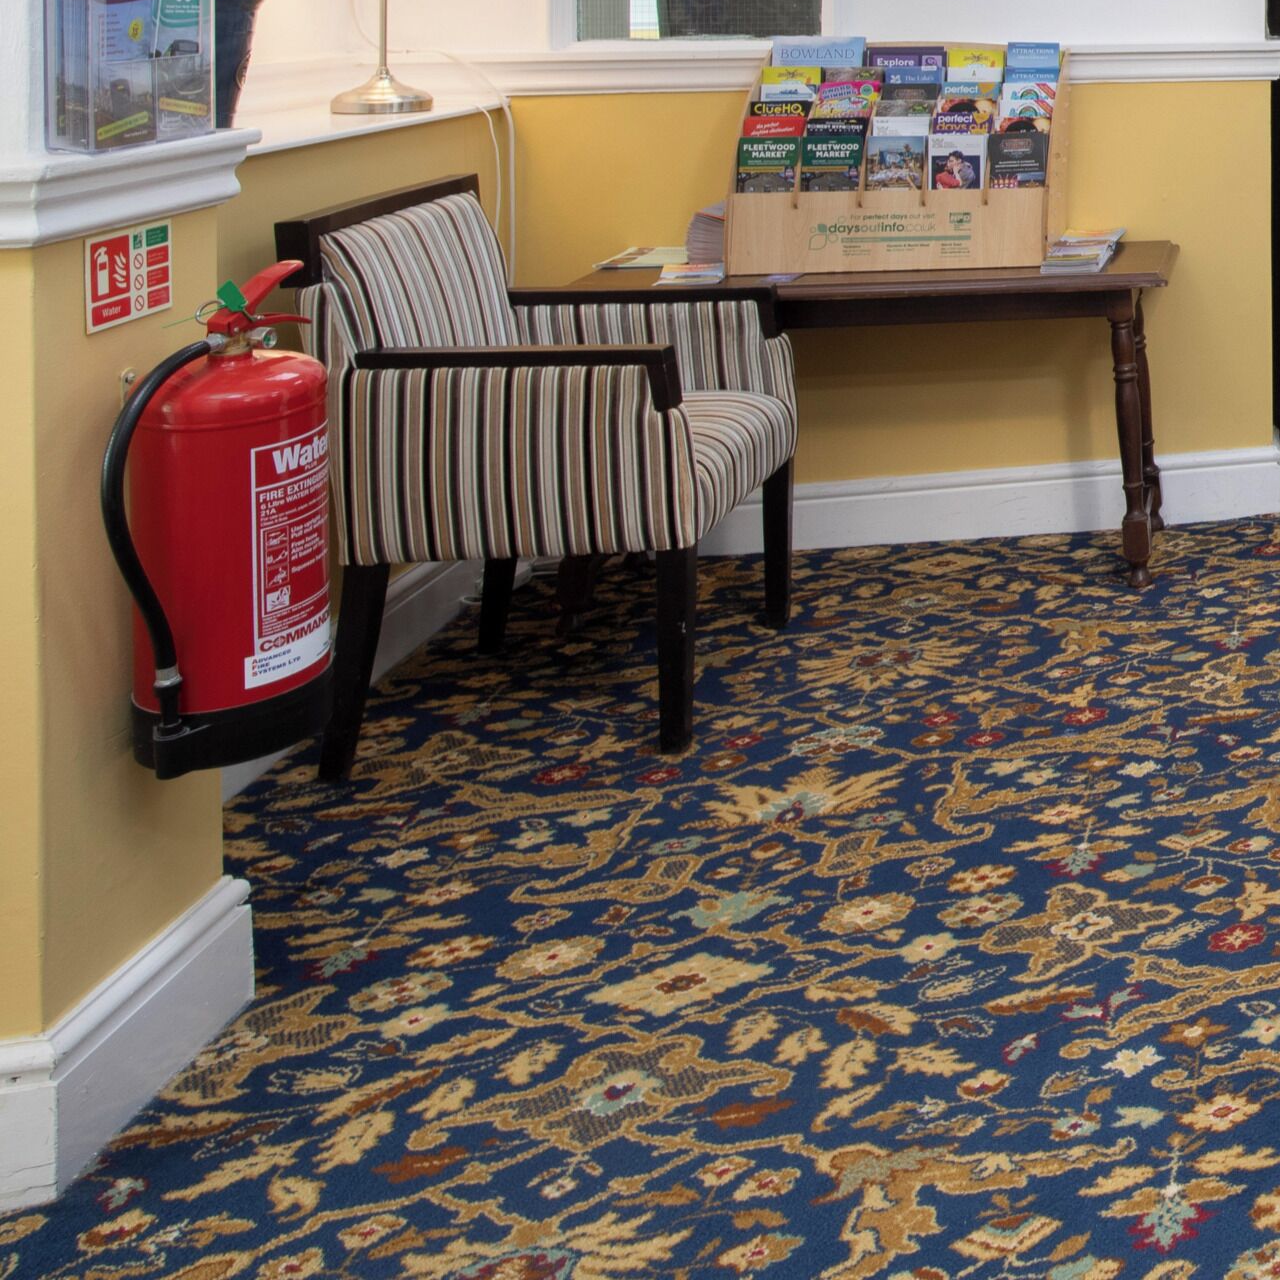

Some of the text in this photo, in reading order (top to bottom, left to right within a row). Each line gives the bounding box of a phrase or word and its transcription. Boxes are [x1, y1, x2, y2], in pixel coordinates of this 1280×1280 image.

[780, 47, 855, 59] BOWLAND
[877, 58, 915, 68] Explore
[944, 85, 979, 94] perfect
[754, 103, 805, 116] ClueHQ
[937, 114, 973, 124] perfect
[936, 123, 989, 131] days out
[743, 144, 796, 152] FLEETWOOD
[807, 143, 860, 151] FLEETWOOD
[862, 213, 889, 221] perfect
[890, 213, 908, 221] days
[101, 305, 121, 318] Water
[272, 431, 329, 475] Wate
[259, 488, 285, 502] FIRE
[261, 502, 267, 510] 6
[286, 489, 310, 503] WATER
[261, 508, 276, 517] 21A
[251, 648, 292, 665] ADVANCED
[251, 662, 270, 671] FIRE
[251, 662, 287, 677] SYSTEMS
